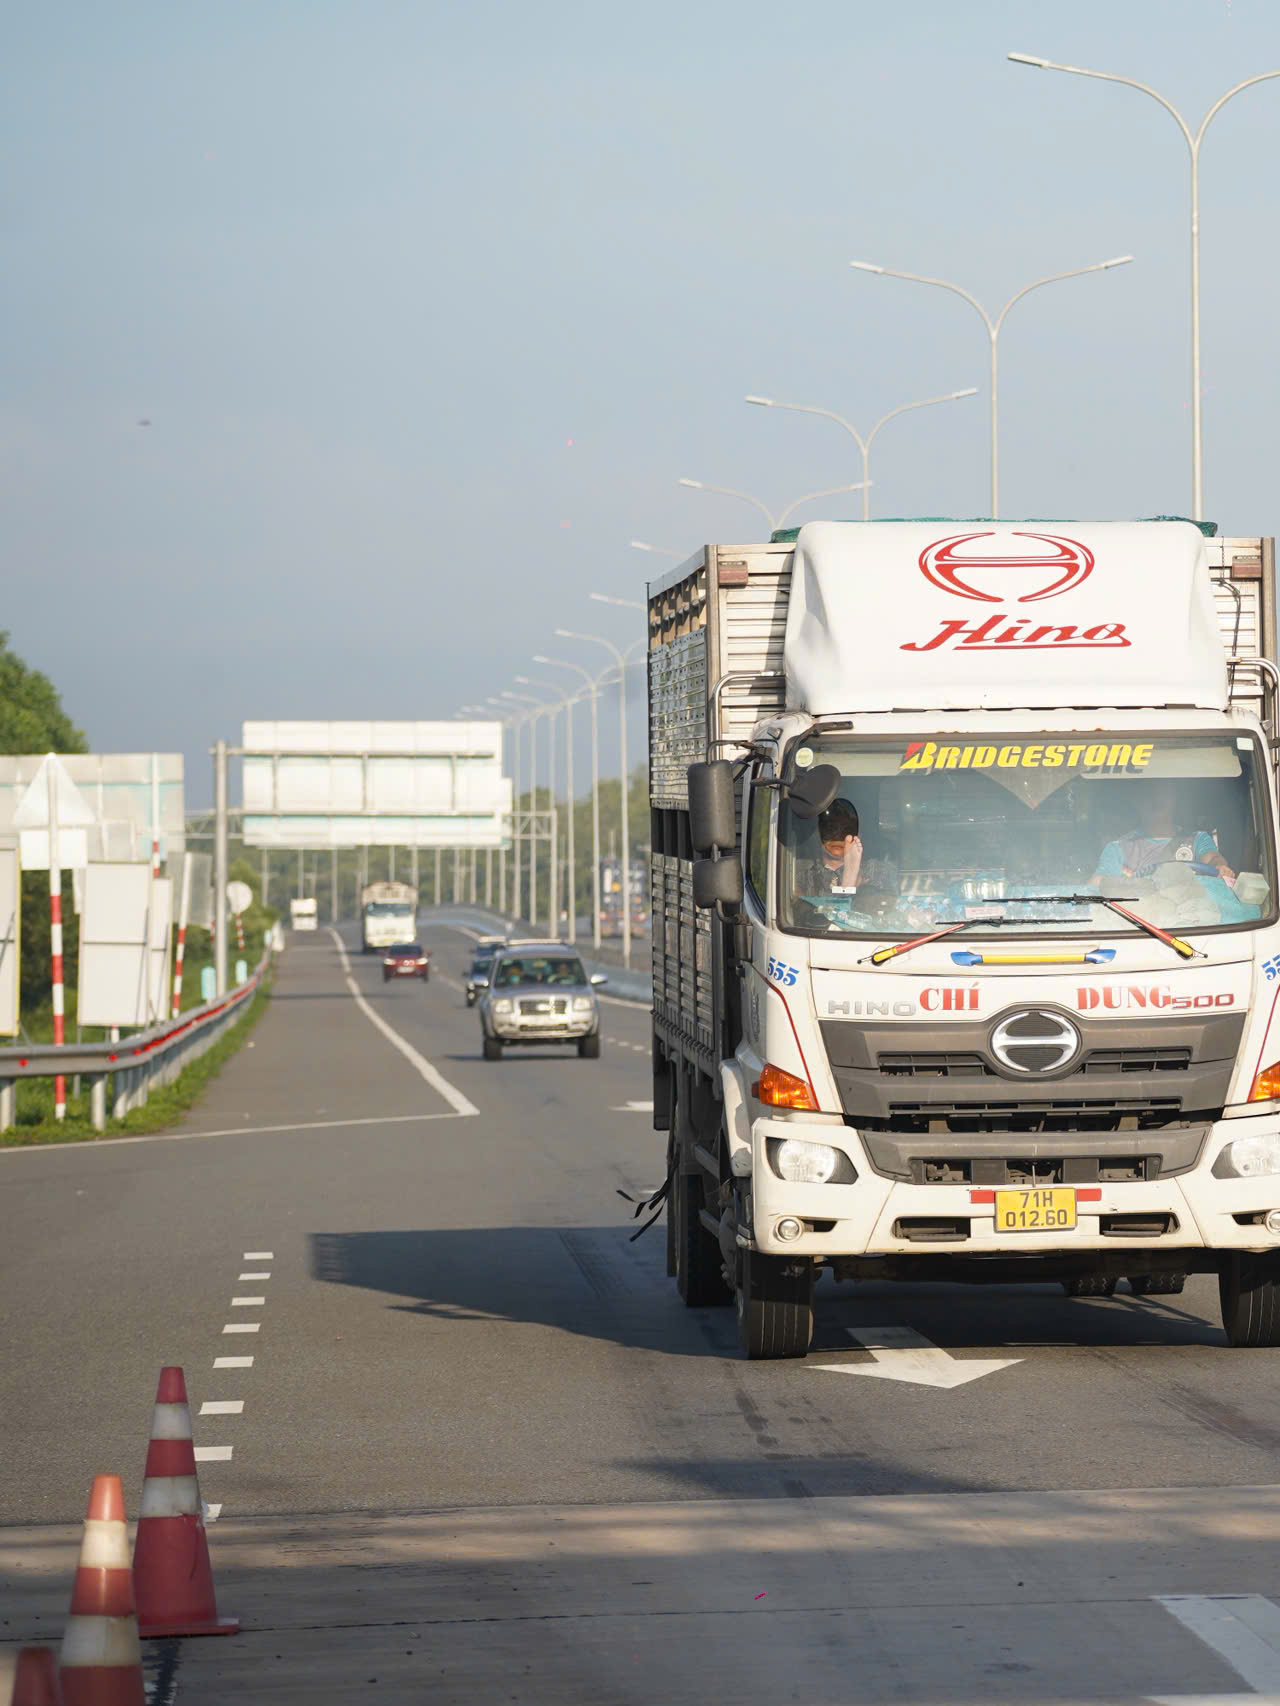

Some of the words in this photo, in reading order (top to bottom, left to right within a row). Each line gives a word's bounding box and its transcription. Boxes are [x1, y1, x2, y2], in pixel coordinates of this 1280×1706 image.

[899, 614, 1132, 651] Hino
[900, 742, 1154, 769] BRIDGESTONE
[767, 956, 800, 987] 555
[919, 981, 981, 1012] CHÍ
[1171, 993, 1235, 1009] 500
[828, 1000, 917, 1016] HINO
[1020, 1191, 1053, 1208] 71H
[1005, 1209, 1068, 1227] 012.60
